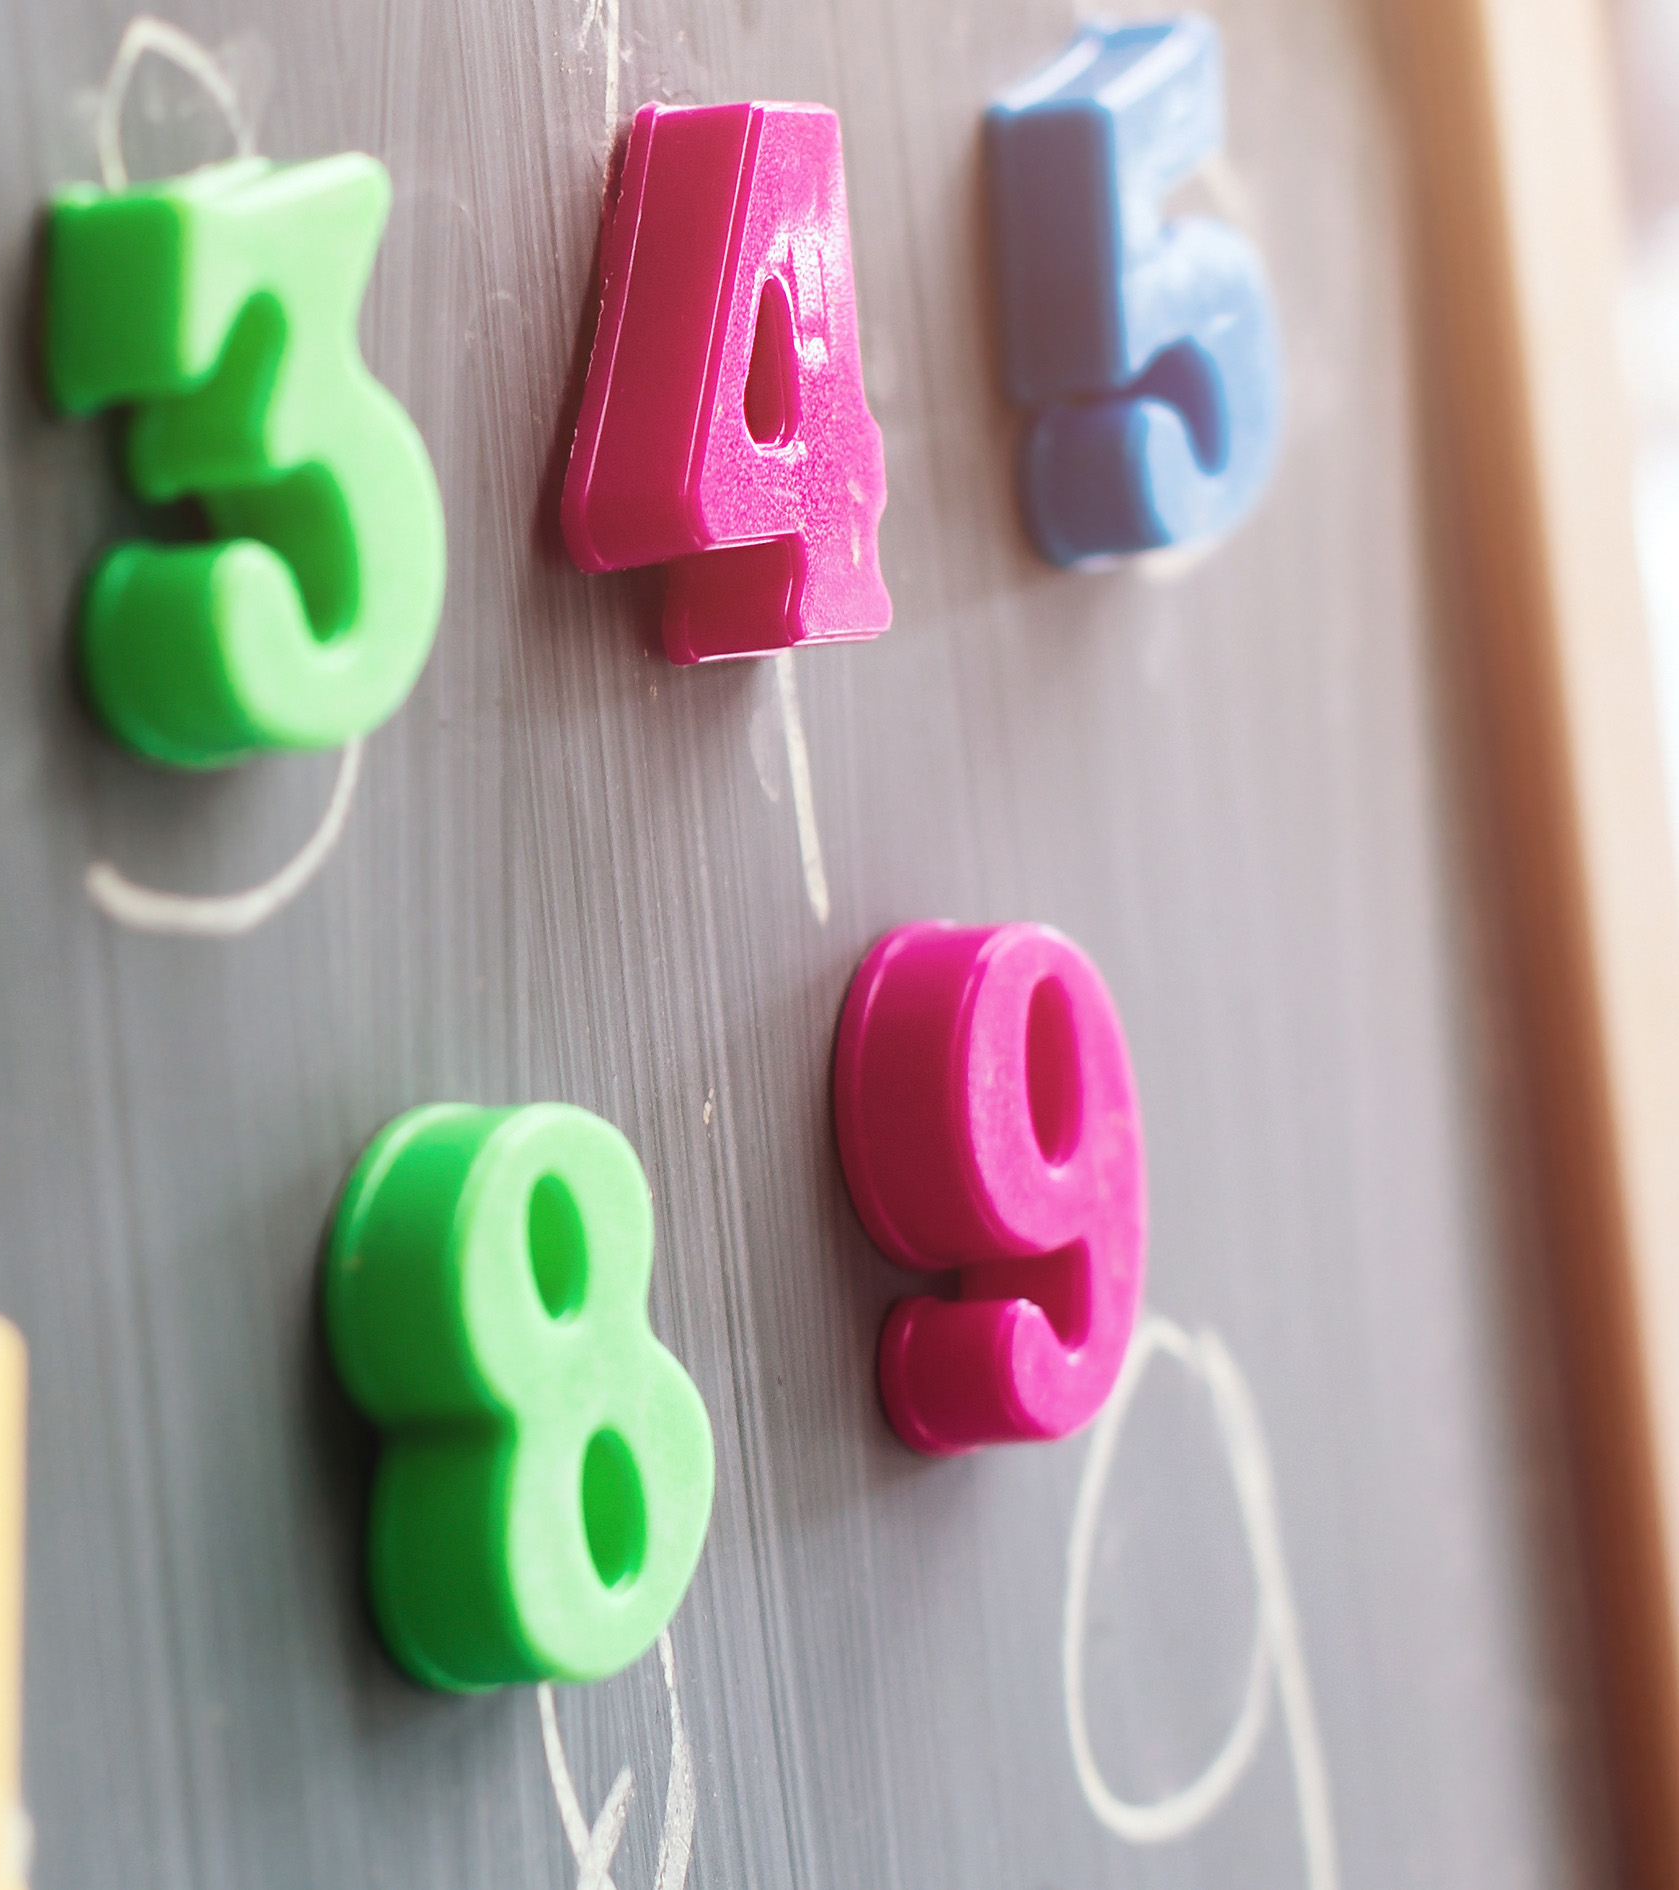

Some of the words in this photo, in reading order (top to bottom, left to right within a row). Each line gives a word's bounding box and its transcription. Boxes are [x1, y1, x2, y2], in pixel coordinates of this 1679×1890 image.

[48, 150, 447, 768] 3
[561, 101, 893, 666] 4
[987, 12, 1282, 568] 5
[325, 1102, 714, 1694] 8
[834, 920, 1148, 1456] 9
[1064, 1315, 1342, 1890] 9
